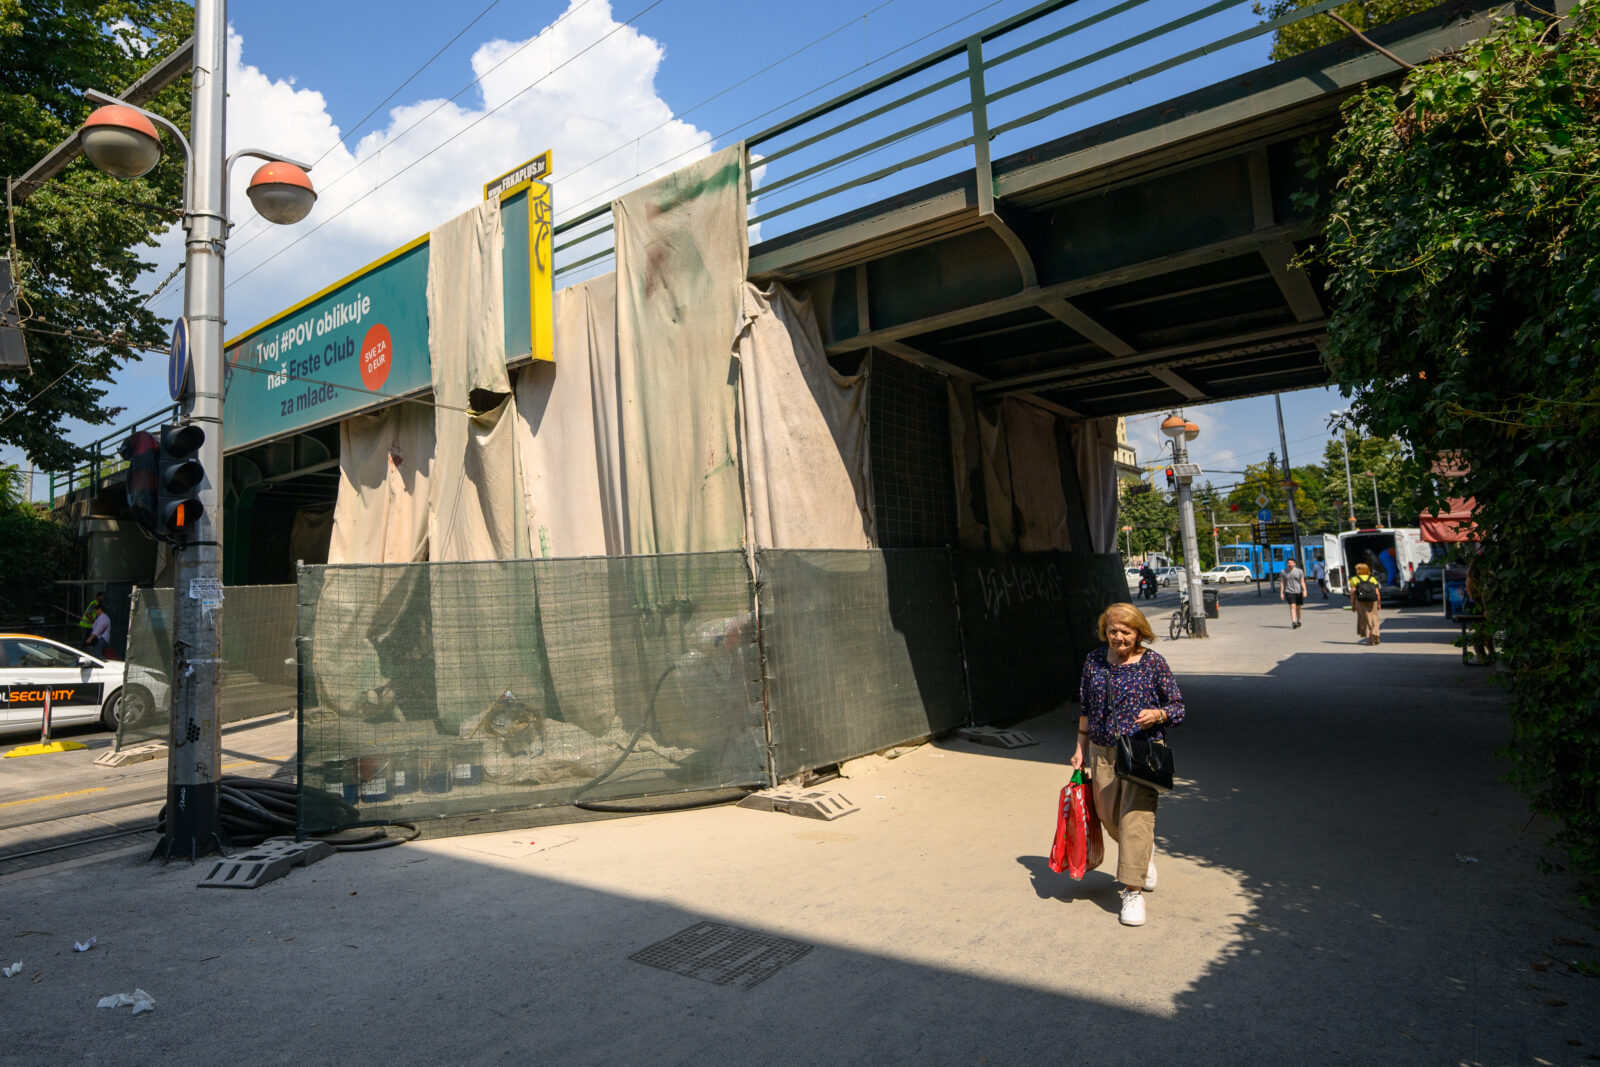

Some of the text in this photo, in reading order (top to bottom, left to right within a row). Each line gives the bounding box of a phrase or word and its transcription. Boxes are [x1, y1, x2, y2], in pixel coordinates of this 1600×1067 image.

[256, 334, 279, 364] Tvoj
[280, 317, 315, 354] #POV
[316, 292, 371, 337] oblikuje
[267, 361, 288, 391] naš
[289, 352, 321, 382] Erste
[323, 335, 355, 367] Club
[364, 340, 387, 363] SVE ZA
[372, 353, 386, 371] EUR
[280, 380, 339, 417] za mlade.
